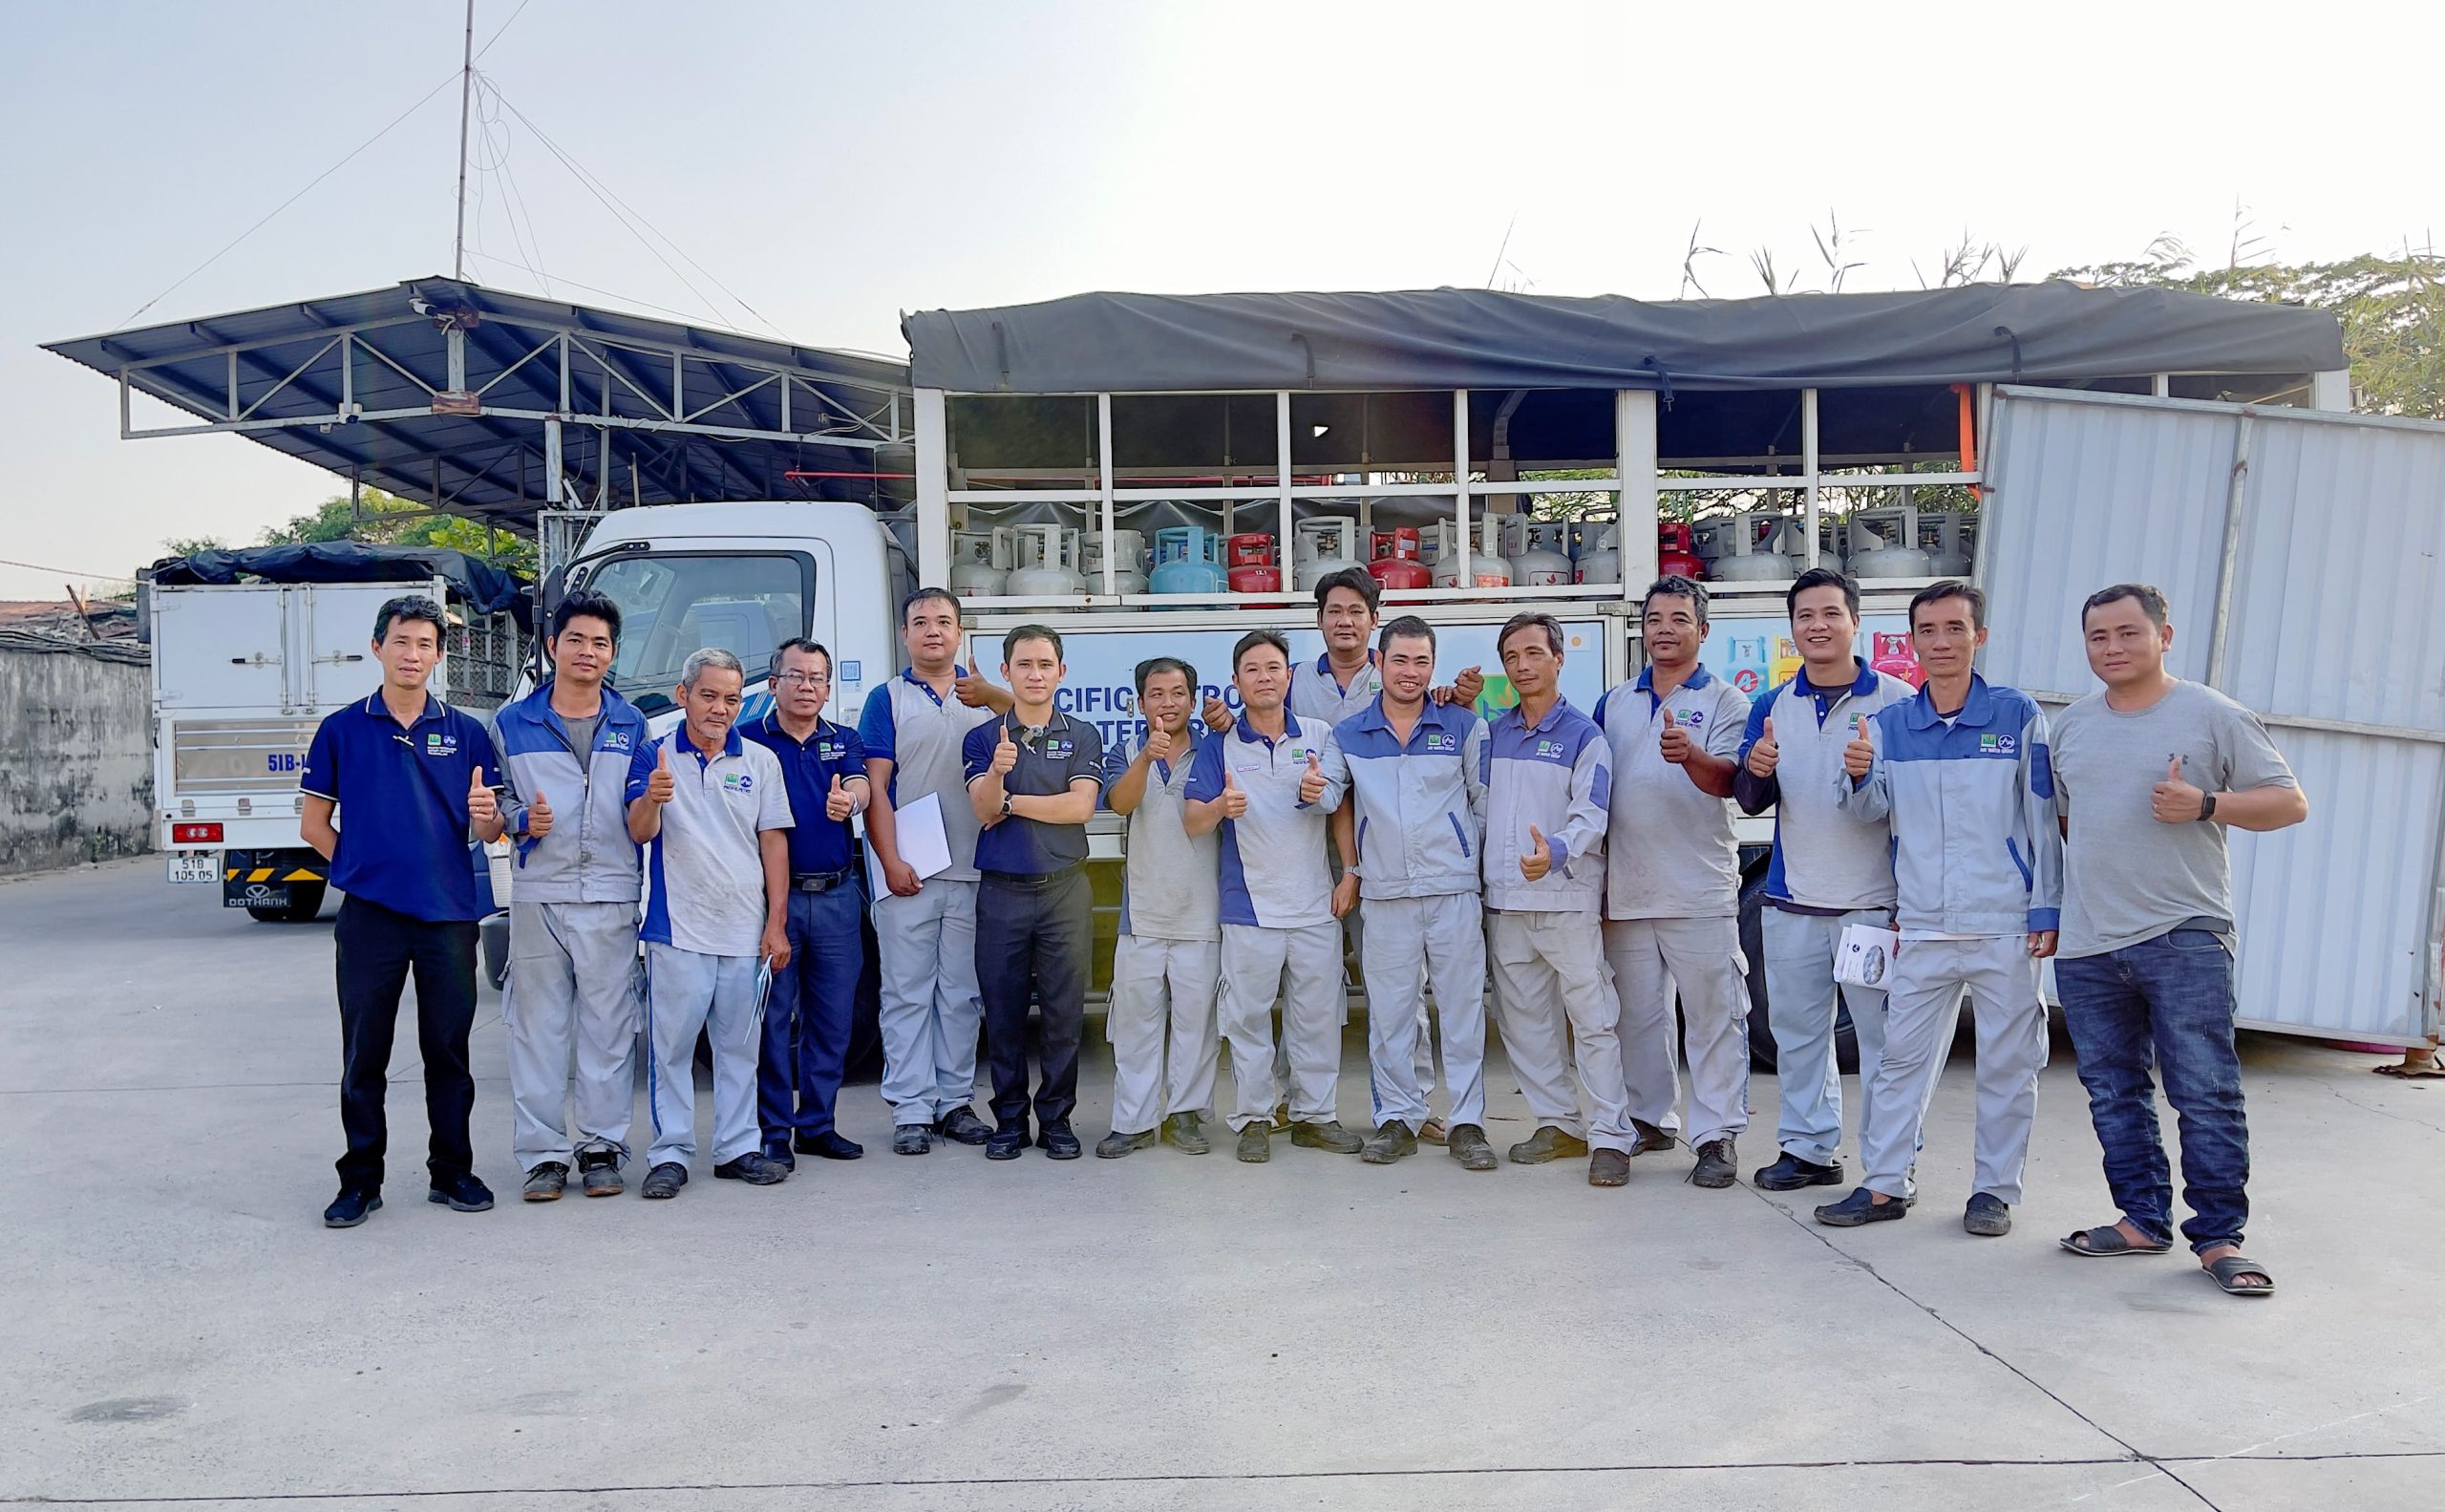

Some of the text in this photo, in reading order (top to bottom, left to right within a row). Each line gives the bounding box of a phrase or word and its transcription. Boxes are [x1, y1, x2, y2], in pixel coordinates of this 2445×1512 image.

[1053, 687, 1134, 713] CIFIC
[268, 754, 306, 772] 51B-1
[181, 859, 204, 869] 51B
[175, 870, 213, 882] 105.05
